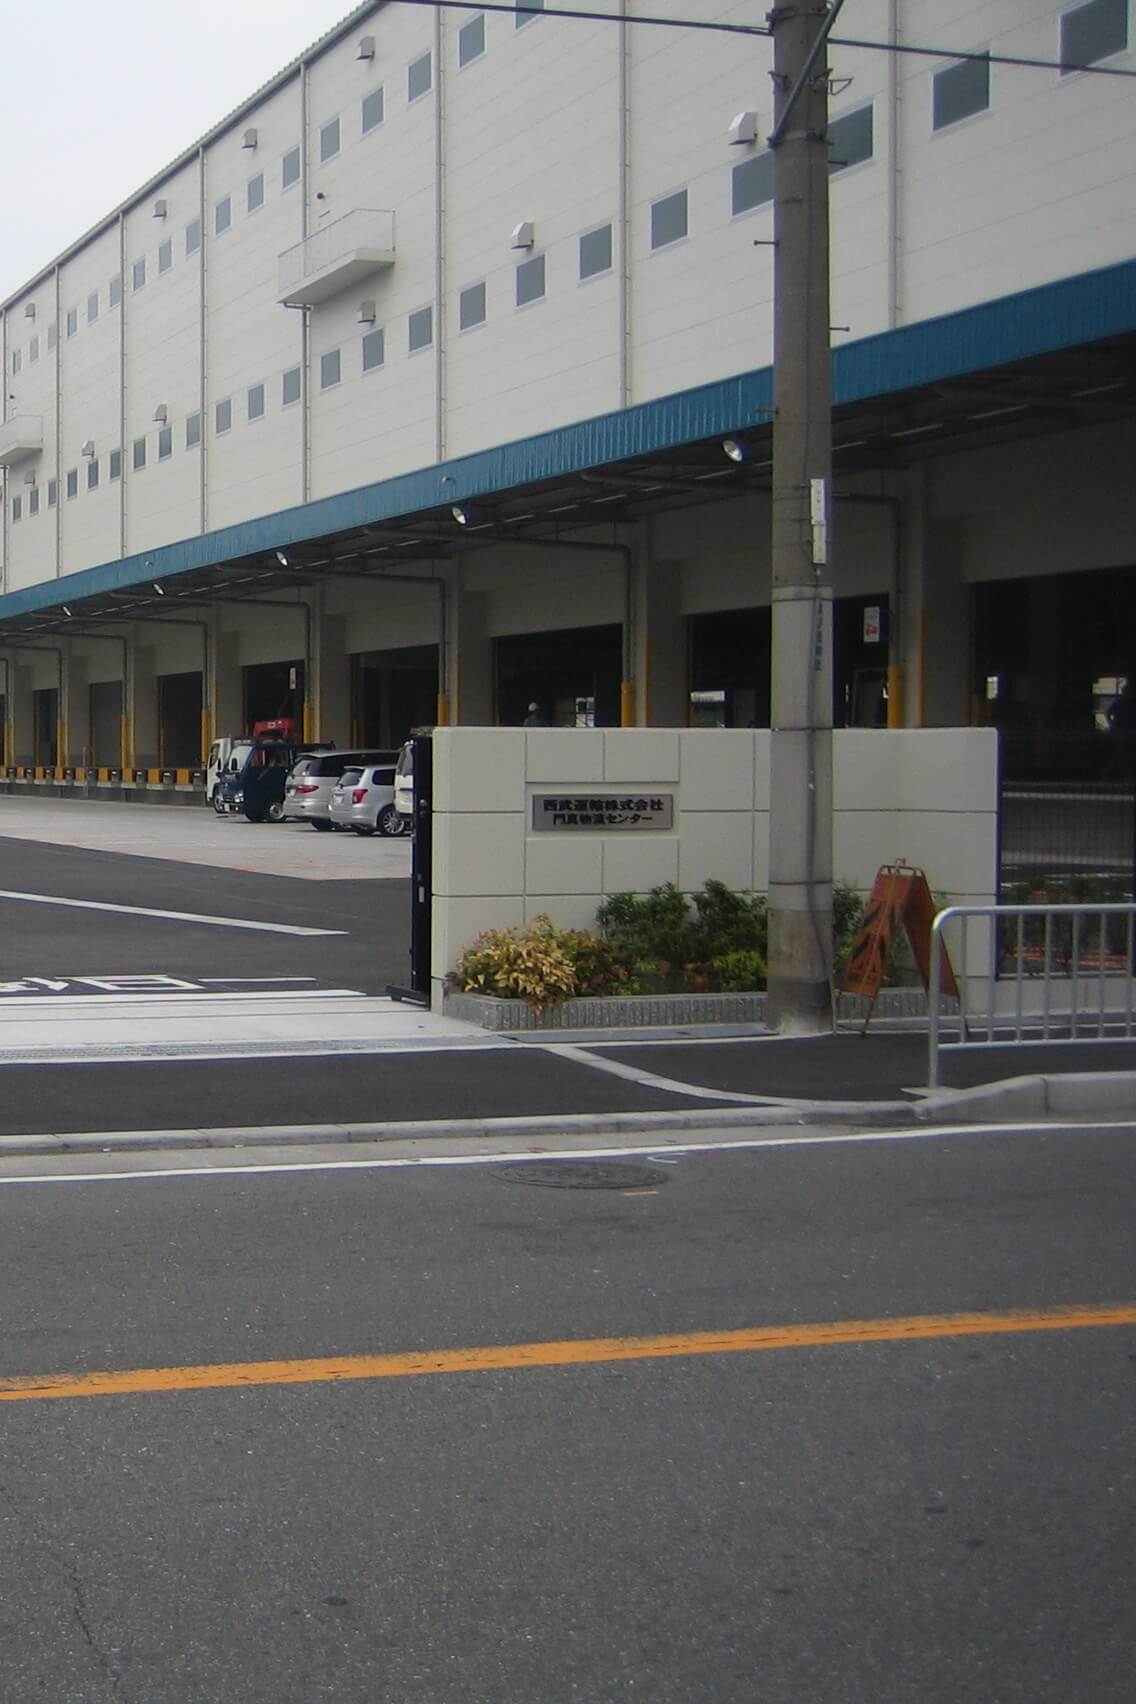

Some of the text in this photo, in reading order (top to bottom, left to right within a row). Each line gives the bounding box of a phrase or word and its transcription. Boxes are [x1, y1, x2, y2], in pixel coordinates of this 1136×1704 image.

[553, 813, 654, 826] 門真物流センター
